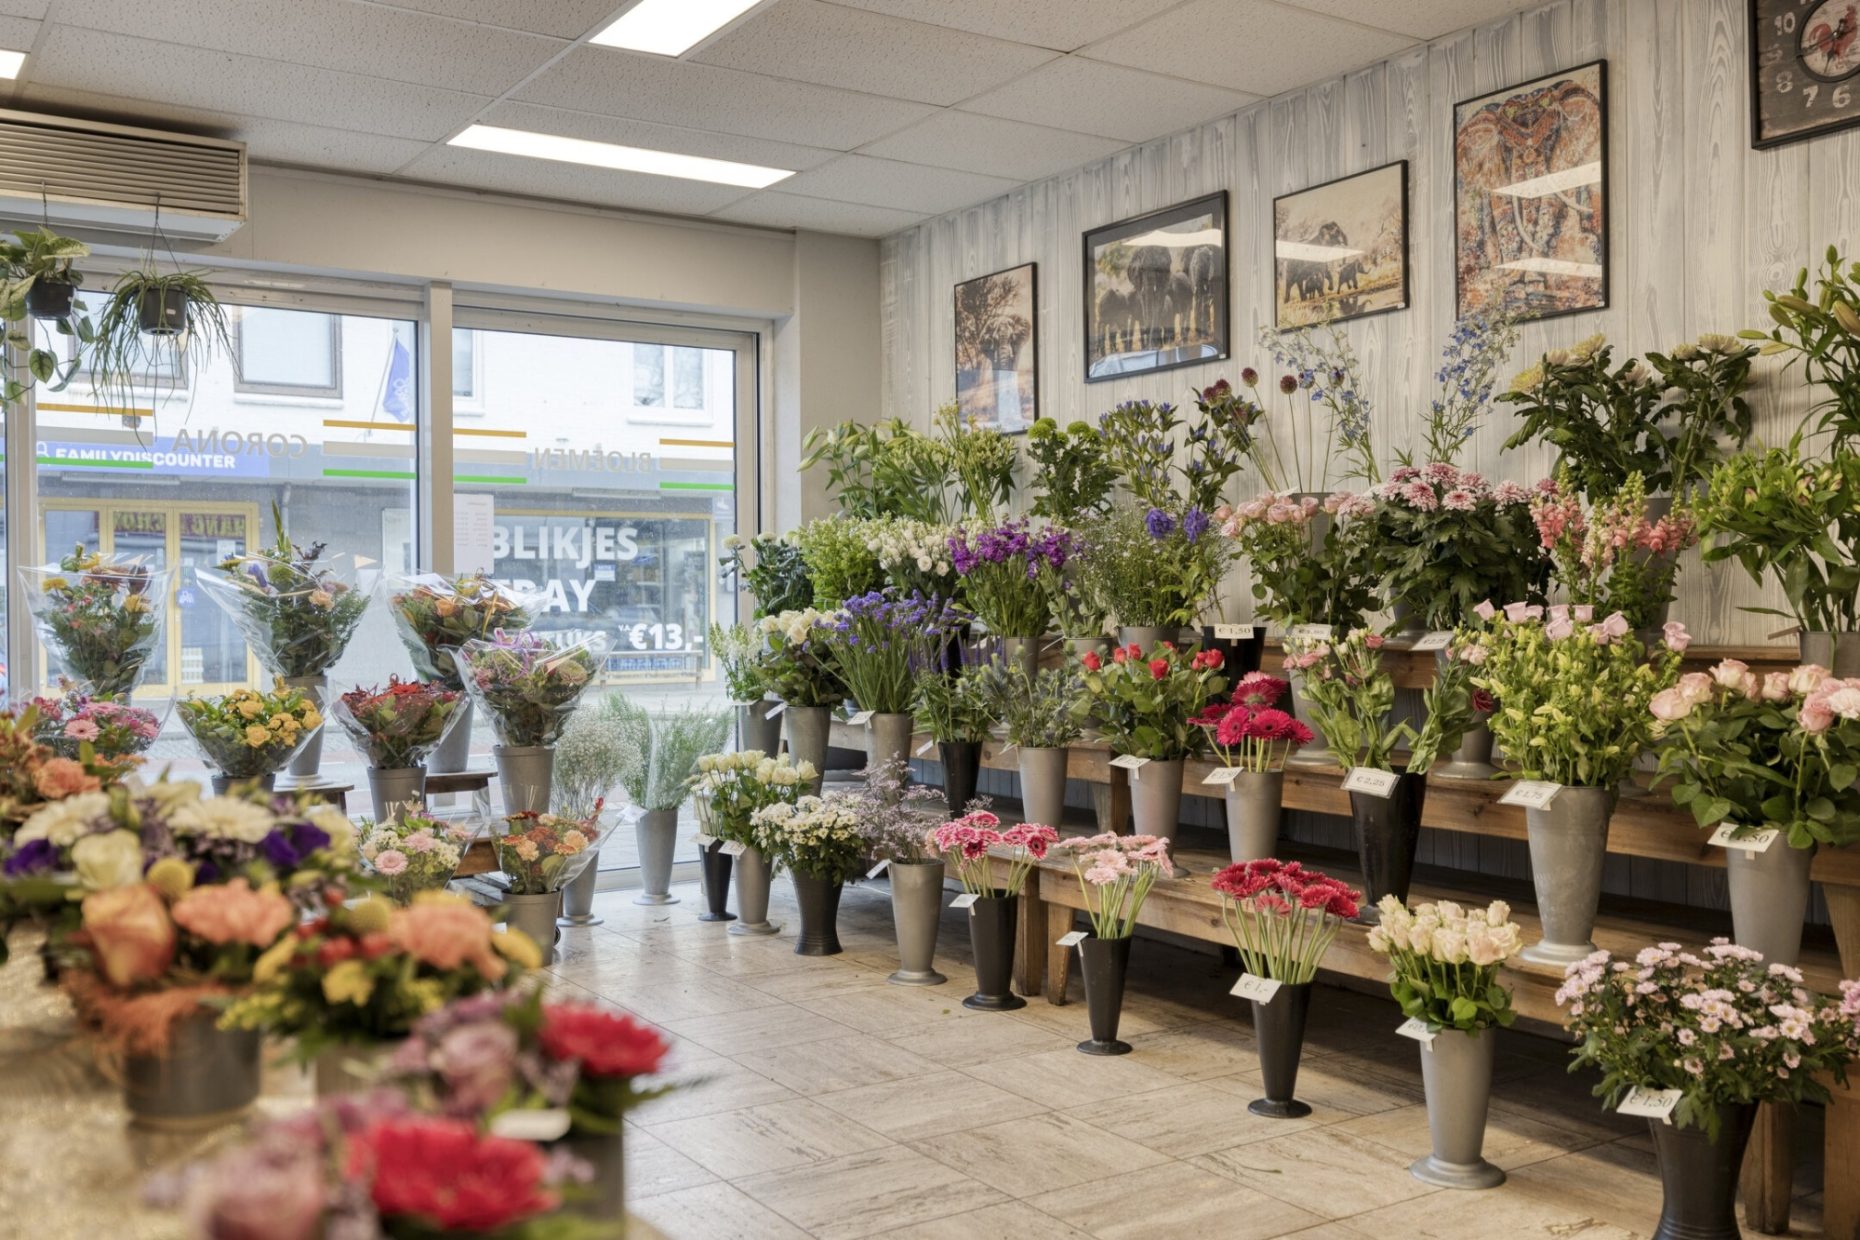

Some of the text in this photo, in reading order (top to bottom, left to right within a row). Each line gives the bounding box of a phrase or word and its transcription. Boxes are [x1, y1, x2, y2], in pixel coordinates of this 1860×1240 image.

[1774, 11, 1796, 36] 10
[1776, 71, 1793, 93] 8
[1803, 85, 1819, 108] 7
[1832, 84, 1852, 108] 6
[494, 525, 639, 569] BLIKJES
[628, 622, 704, 652] €13,-
